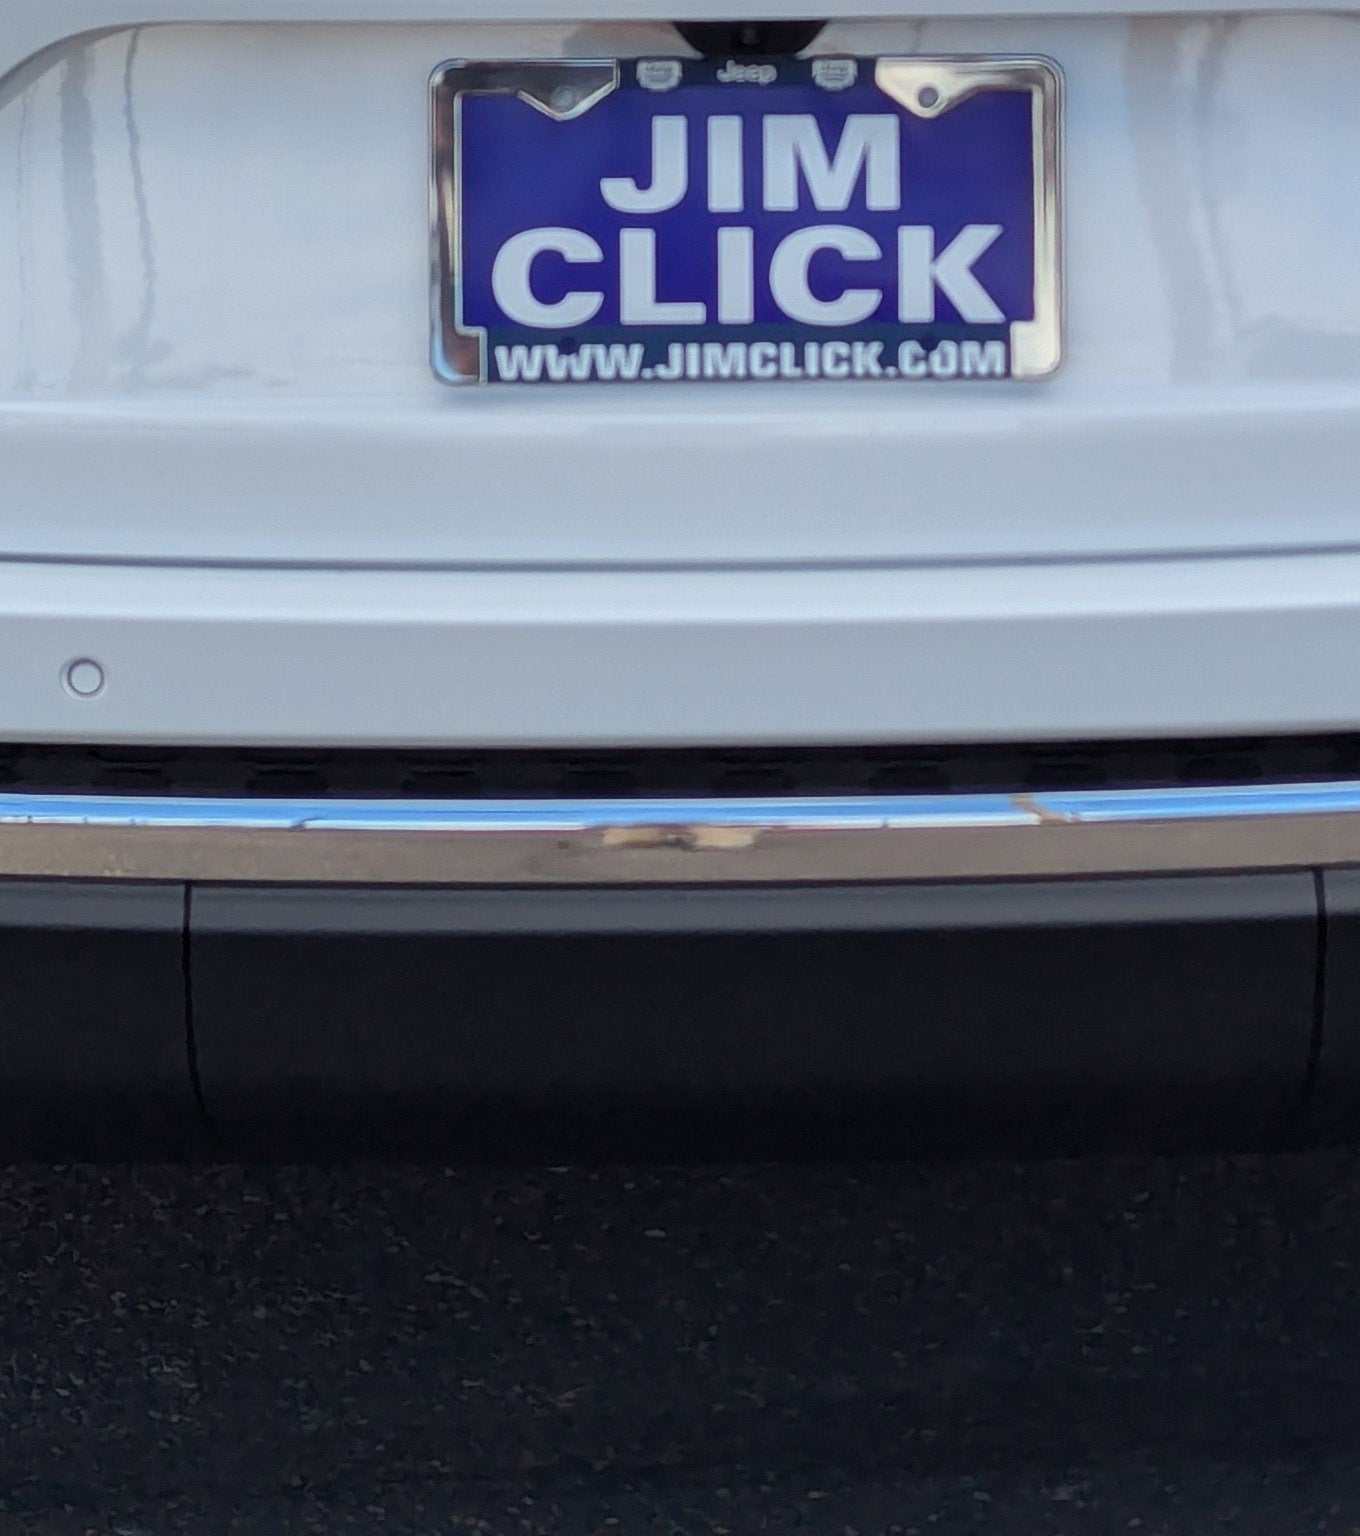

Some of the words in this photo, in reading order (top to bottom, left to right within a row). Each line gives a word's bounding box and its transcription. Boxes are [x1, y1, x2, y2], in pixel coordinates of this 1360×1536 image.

[600, 114, 901, 213] JIM
[492, 224, 1006, 327] CLICK
[495, 340, 1006, 380] WWW.JIMCLICK.COM
